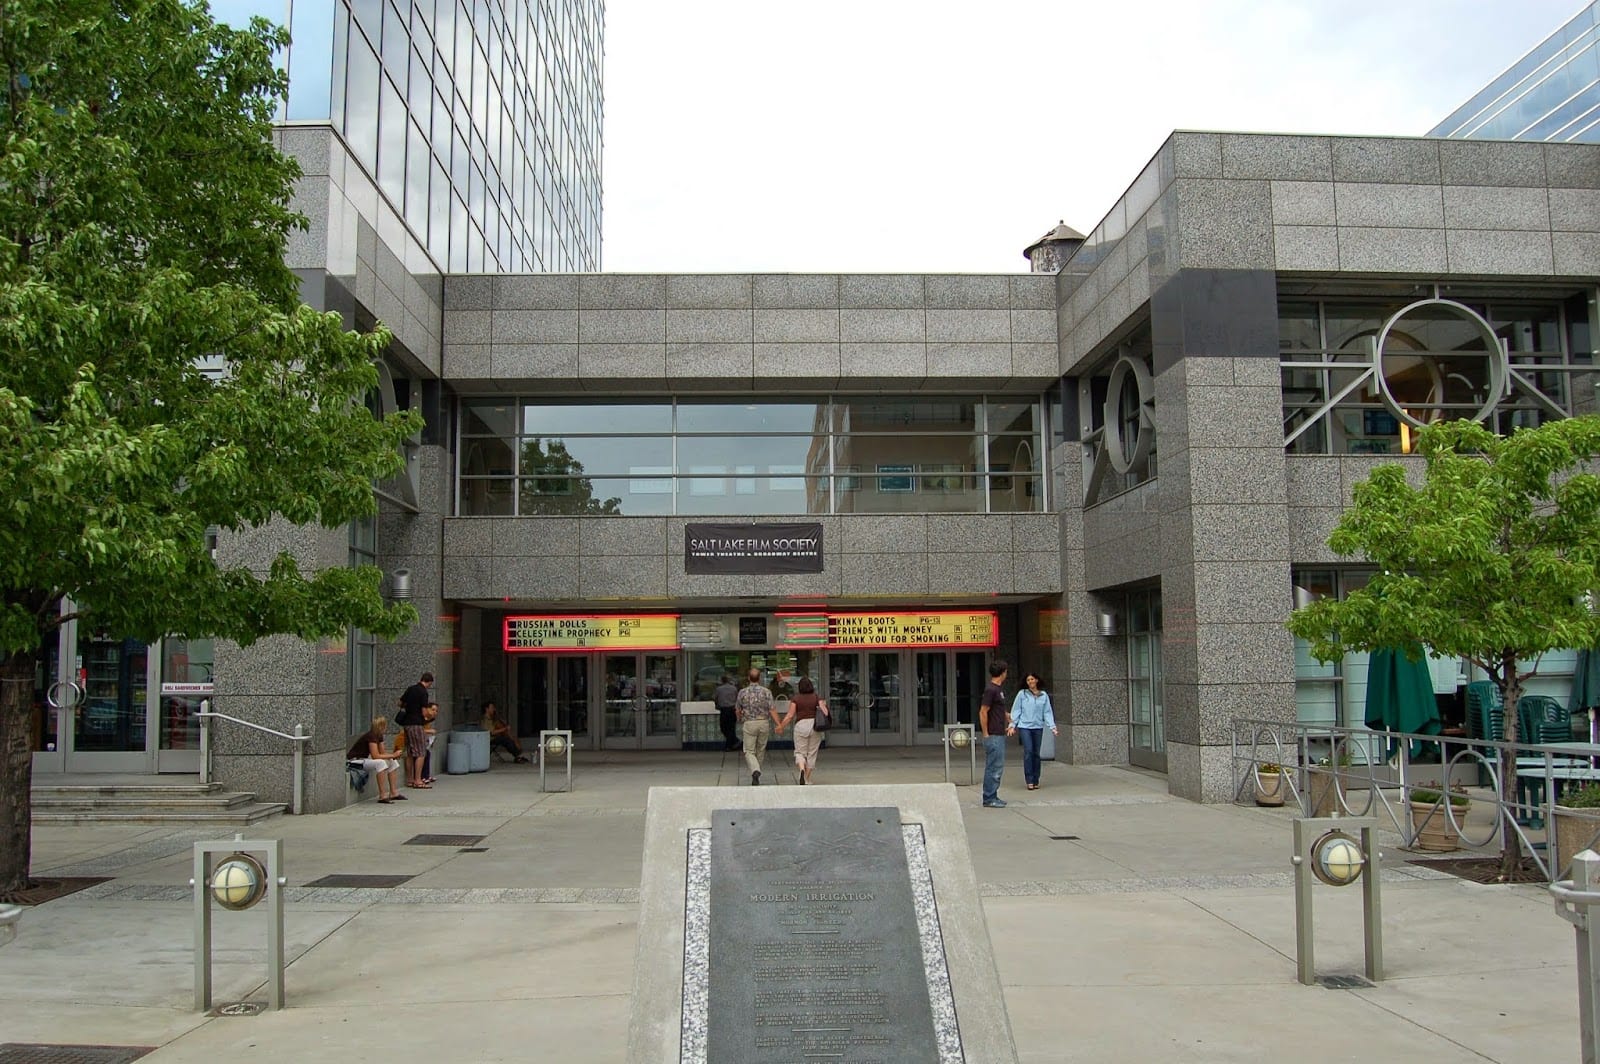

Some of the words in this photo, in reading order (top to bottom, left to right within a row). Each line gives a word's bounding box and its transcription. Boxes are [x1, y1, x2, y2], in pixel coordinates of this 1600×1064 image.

[691, 539, 716, 550] SALT
[718, 539, 744, 550] LAKE
[747, 539, 770, 550] FILM
[772, 538, 817, 550] SOCIETY
[517, 620, 554, 628] RUSSIAN
[560, 620, 587, 628] DOLLS
[868, 617, 896, 625] BOOTS
[516, 629, 563, 637] CELESTINE
[567, 629, 611, 637] PROPHECY
[837, 626, 873, 634] FRIENDS
[877, 626, 898, 634] WITH
[903, 626, 932, 634] MONEY
[891, 635, 907, 643] FOR
[910, 634, 949, 642] SMOKING
[517, 639, 543, 647] BRICK
[750, 893, 799, 902] MODERN
[806, 892, 875, 901] IRRIGATION
